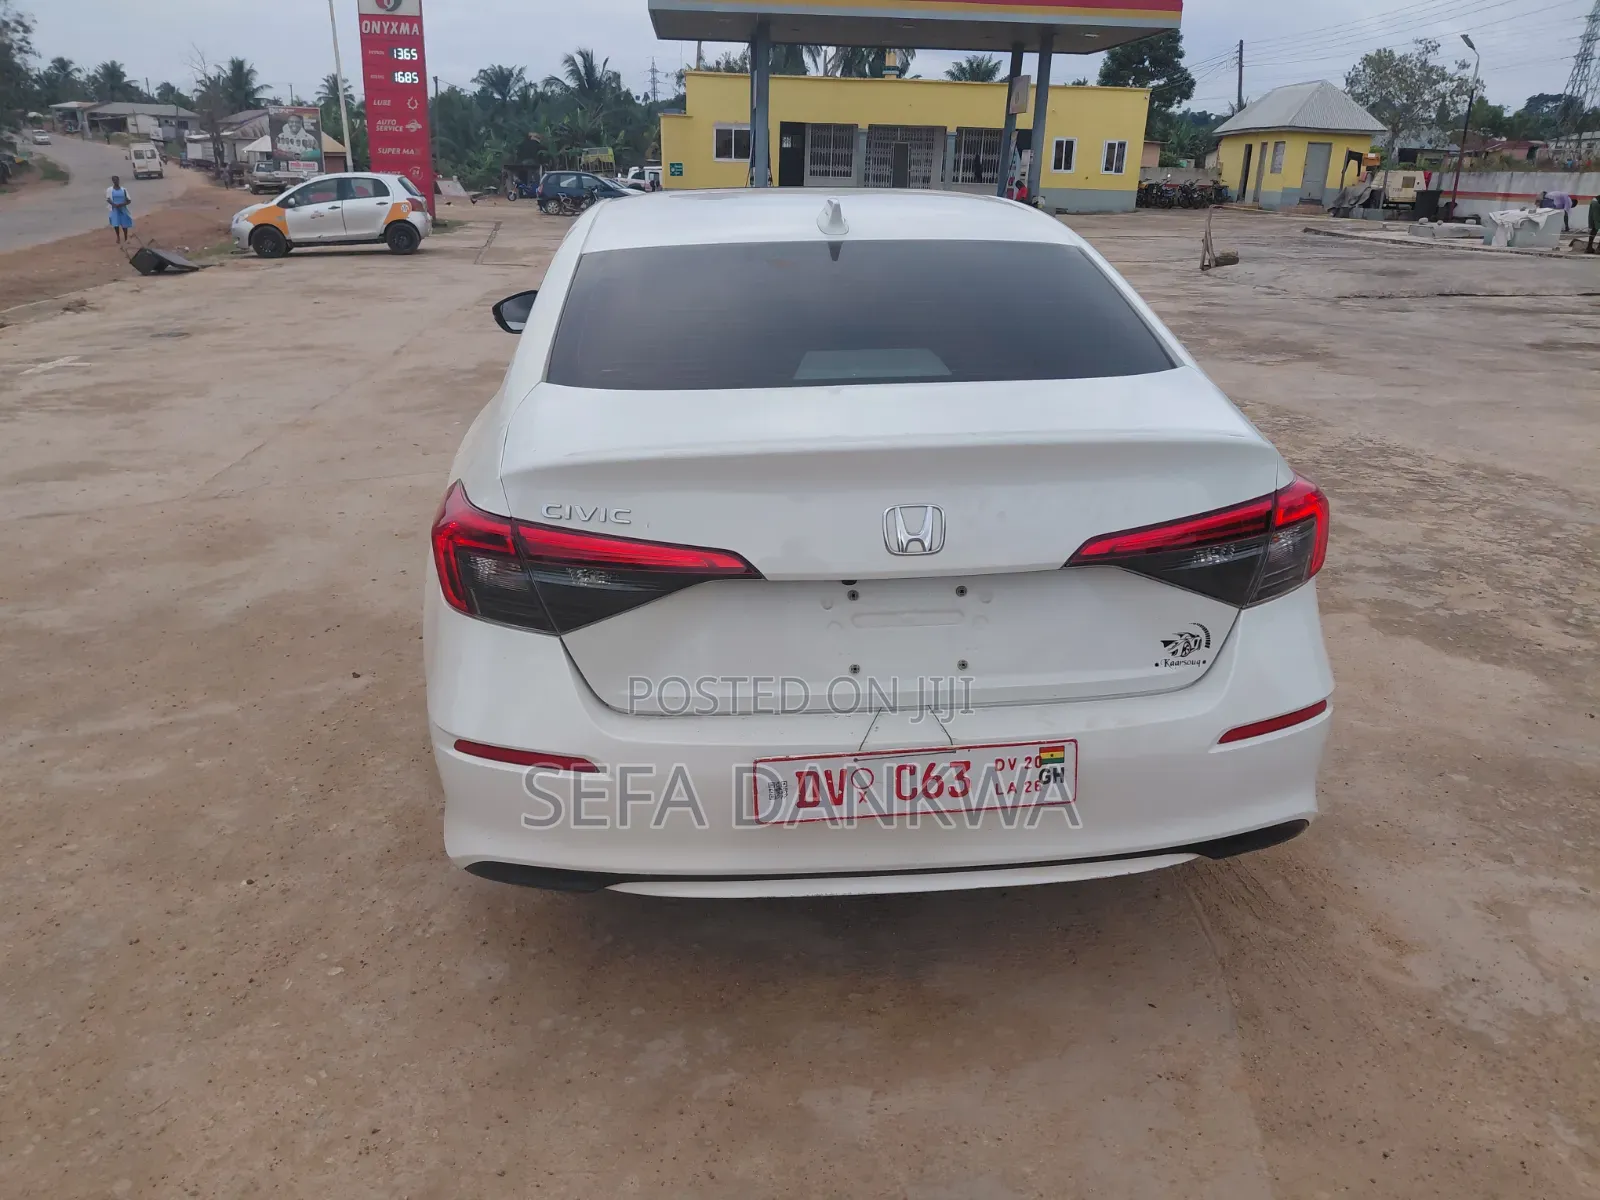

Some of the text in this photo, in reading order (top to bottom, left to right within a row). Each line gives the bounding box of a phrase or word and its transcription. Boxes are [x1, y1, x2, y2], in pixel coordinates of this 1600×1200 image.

[361, 19, 420, 36] ONYXMA
[372, 99, 392, 107] LUBE
[375, 125, 404, 133] SERVICE
[377, 147, 401, 155] SUPER
[541, 502, 633, 526] CIVIC
[994, 755, 1043, 772] DV 20
[1038, 766, 1065, 785] GH
[794, 760, 972, 809] DV C63
[994, 780, 1018, 796] LA
